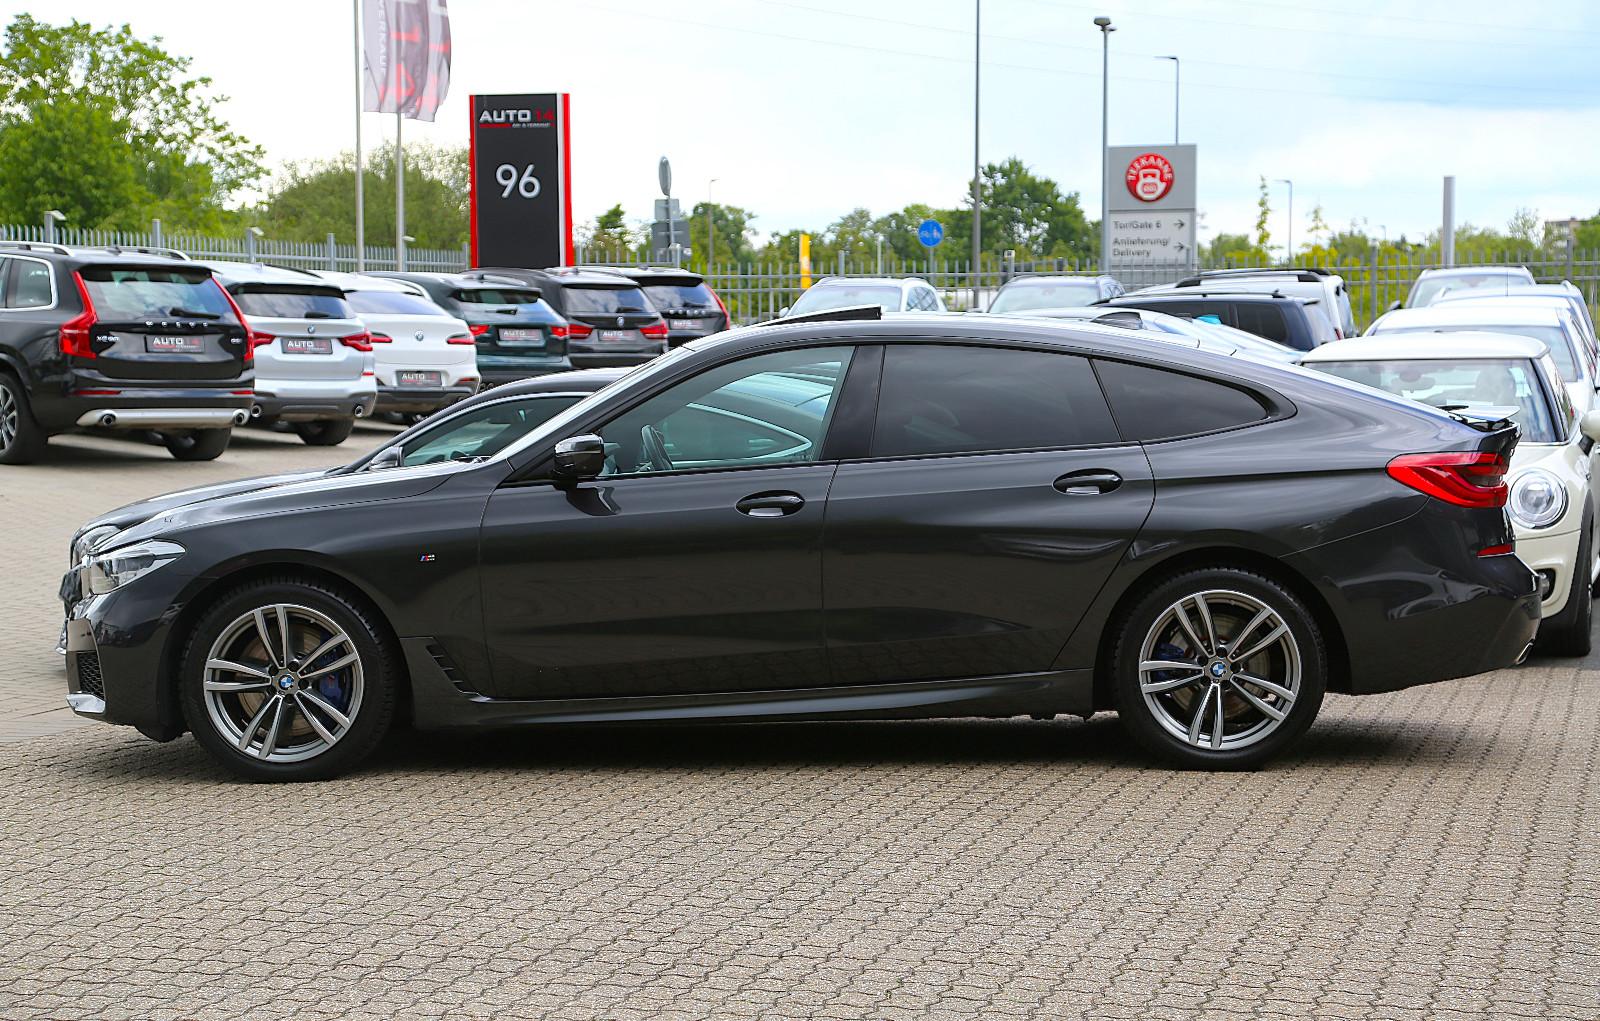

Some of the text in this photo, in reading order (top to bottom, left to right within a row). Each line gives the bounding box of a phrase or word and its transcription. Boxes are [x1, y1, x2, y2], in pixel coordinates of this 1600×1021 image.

[479, 109, 555, 123] AUTO 14
[496, 163, 541, 198] 96
[1112, 248, 1152, 258] Delivery
[152, 337, 184, 345] AUTO
[287, 340, 315, 348] AUTO
